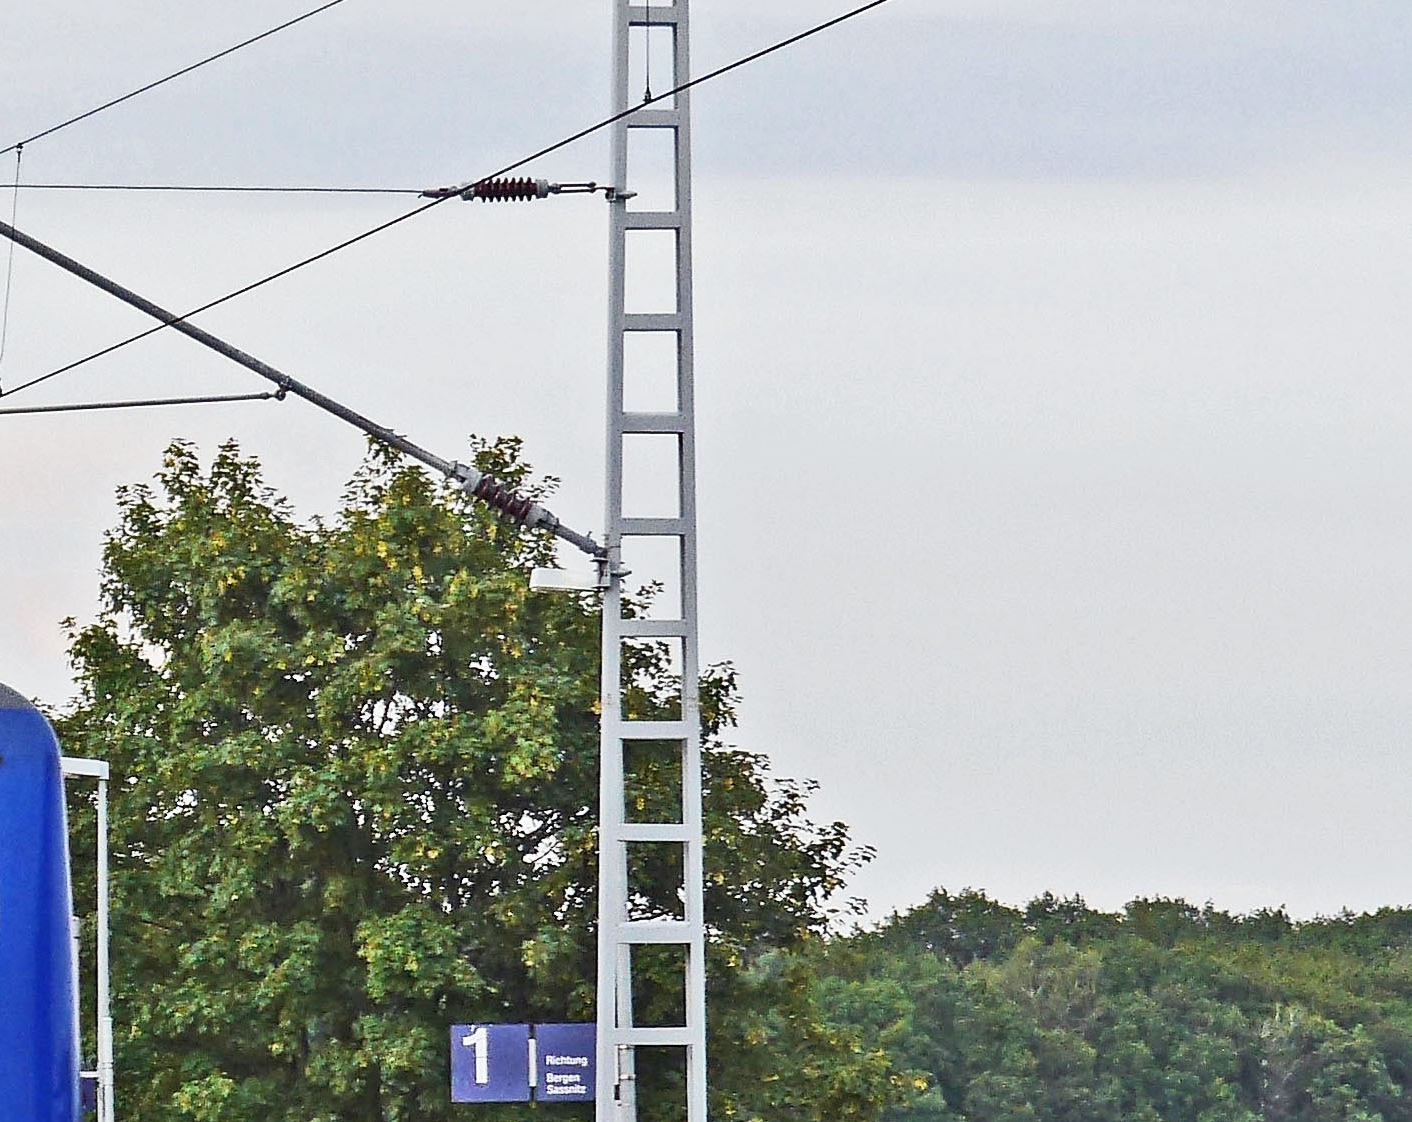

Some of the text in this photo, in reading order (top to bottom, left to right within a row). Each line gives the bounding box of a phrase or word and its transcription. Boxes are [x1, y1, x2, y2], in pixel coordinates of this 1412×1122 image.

[462, 1028, 489, 1084] 1
[545, 1055, 588, 1067] Richtung
[546, 1073, 581, 1084] Bergen
